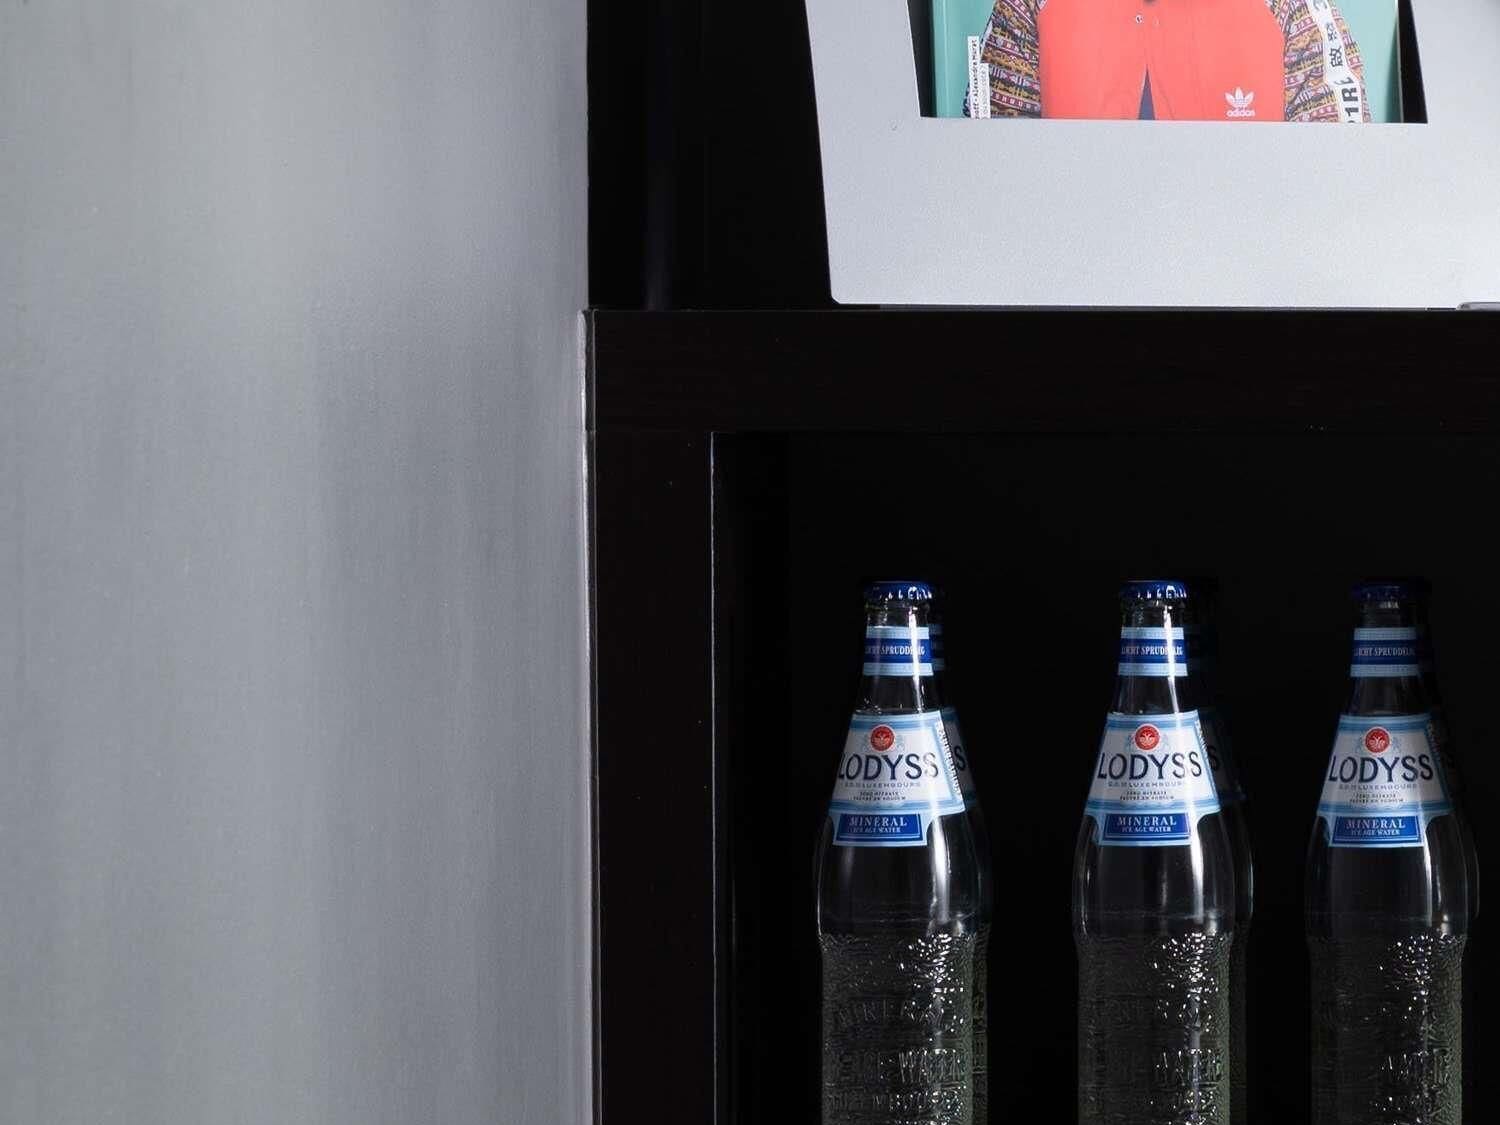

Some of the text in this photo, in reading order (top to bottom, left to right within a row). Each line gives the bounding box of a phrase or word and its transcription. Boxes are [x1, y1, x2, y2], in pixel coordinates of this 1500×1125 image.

[1333, 76, 1360, 123] 1RE
[1226, 108, 1256, 117] adidas
[839, 752, 939, 780] LODYSS
[1097, 751, 1202, 780] LODYSS
[1328, 754, 1434, 783] LODYSS
[848, 816, 908, 827] MINERAL
[1117, 815, 1177, 826] MINERAL
[1345, 819, 1406, 829] MINERAL
